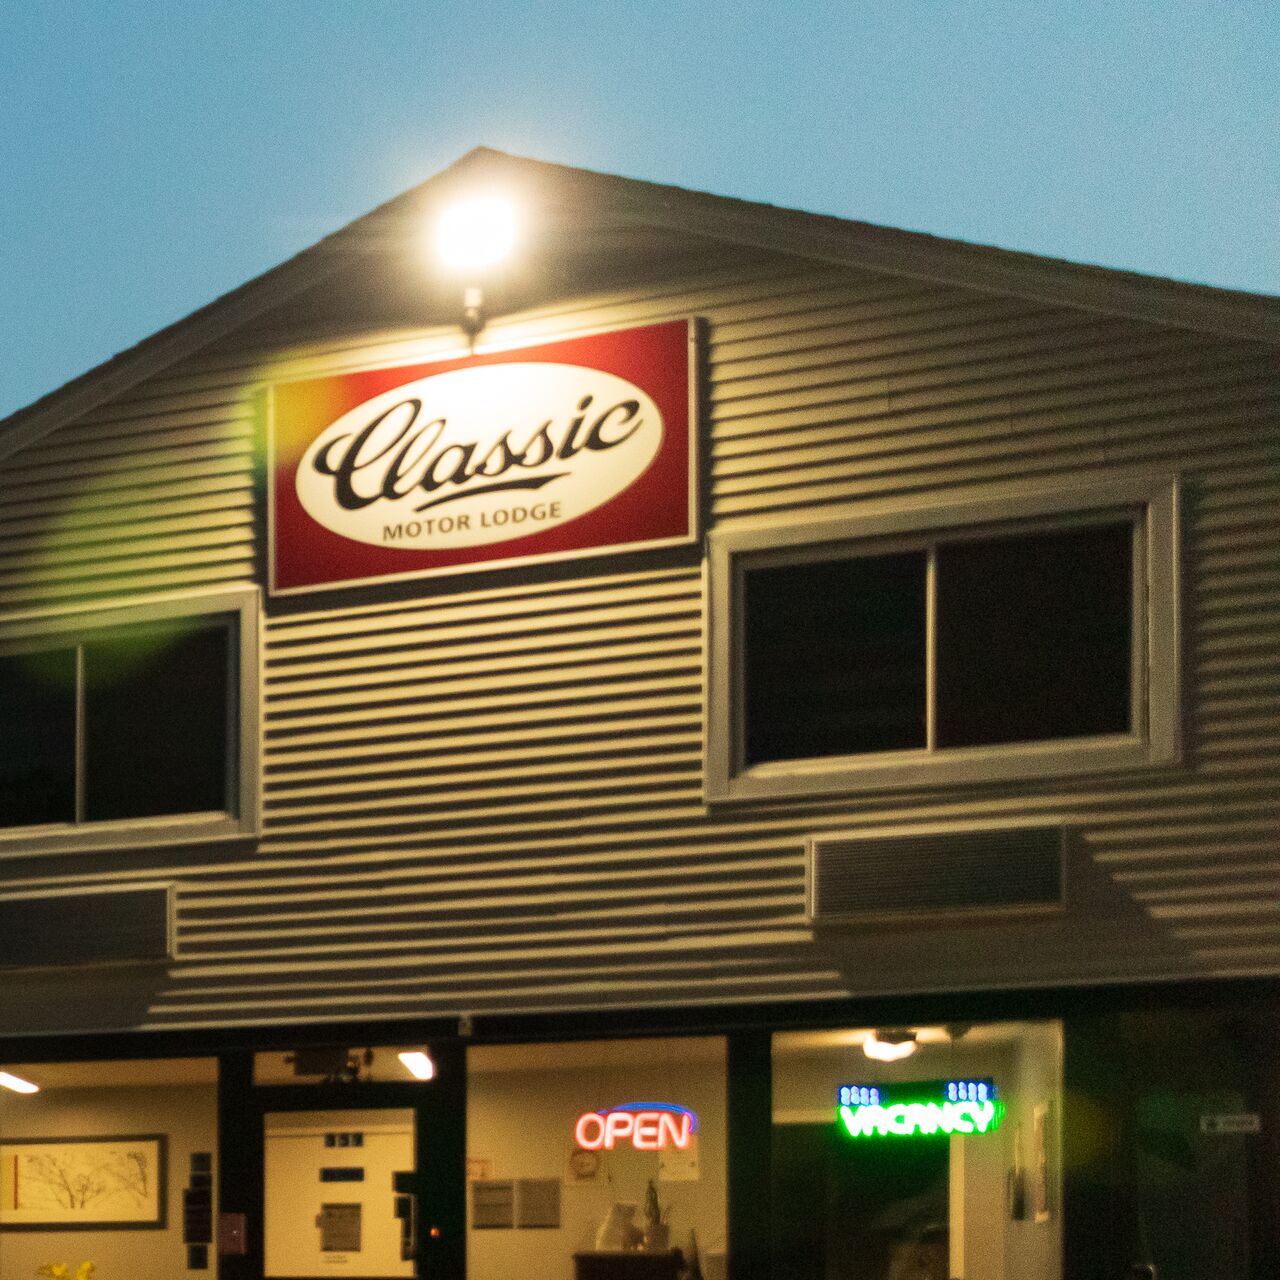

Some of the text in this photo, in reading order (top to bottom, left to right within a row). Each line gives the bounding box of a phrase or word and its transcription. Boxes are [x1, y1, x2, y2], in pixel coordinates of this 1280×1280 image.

[313, 395, 643, 511] Classic
[382, 501, 562, 541] MOTOR LODGE
[575, 1111, 691, 1150] OPEN
[839, 1101, 995, 1137] VACANCY
